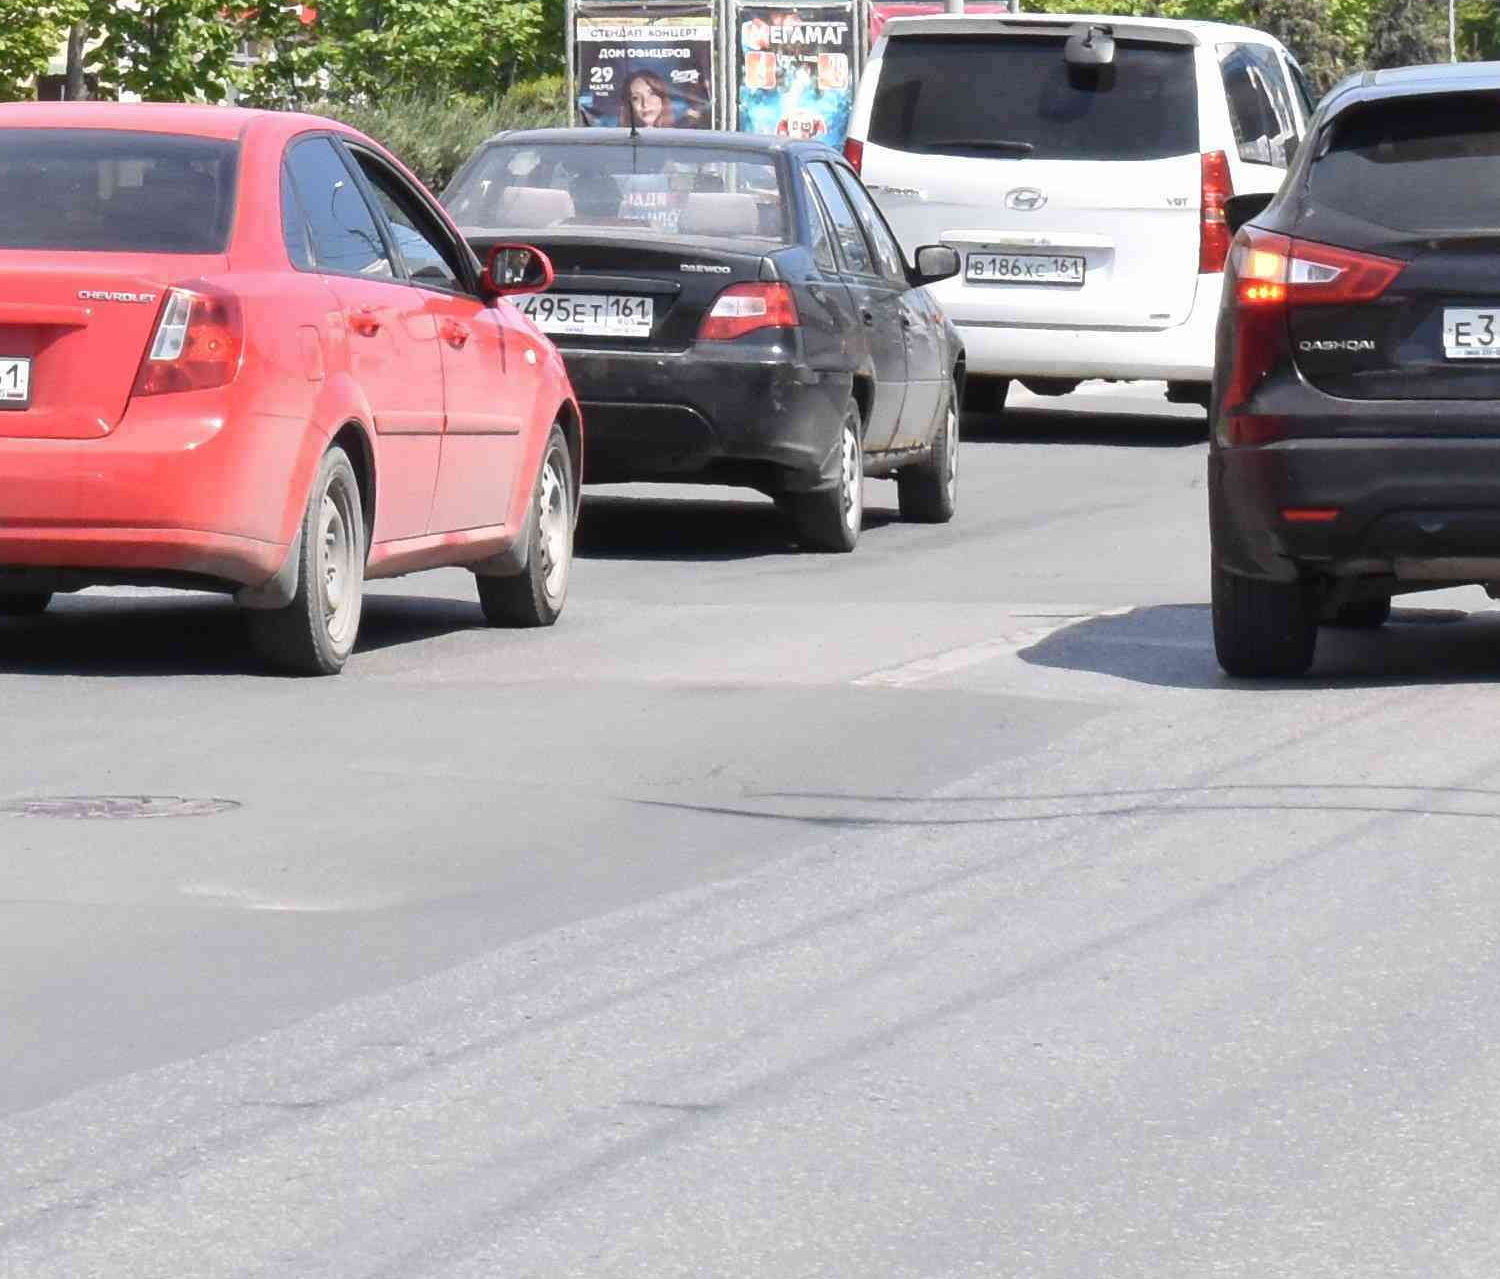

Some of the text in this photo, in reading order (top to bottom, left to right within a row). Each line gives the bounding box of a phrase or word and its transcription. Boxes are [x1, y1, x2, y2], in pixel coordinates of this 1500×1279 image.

[598, 49, 625, 60] ДОМ
[590, 67, 614, 84] 29
[77, 290, 158, 303] CHEVROLET
[515, 297, 603, 324] 495ЕТ
[1298, 340, 1377, 353] QASHQAI
